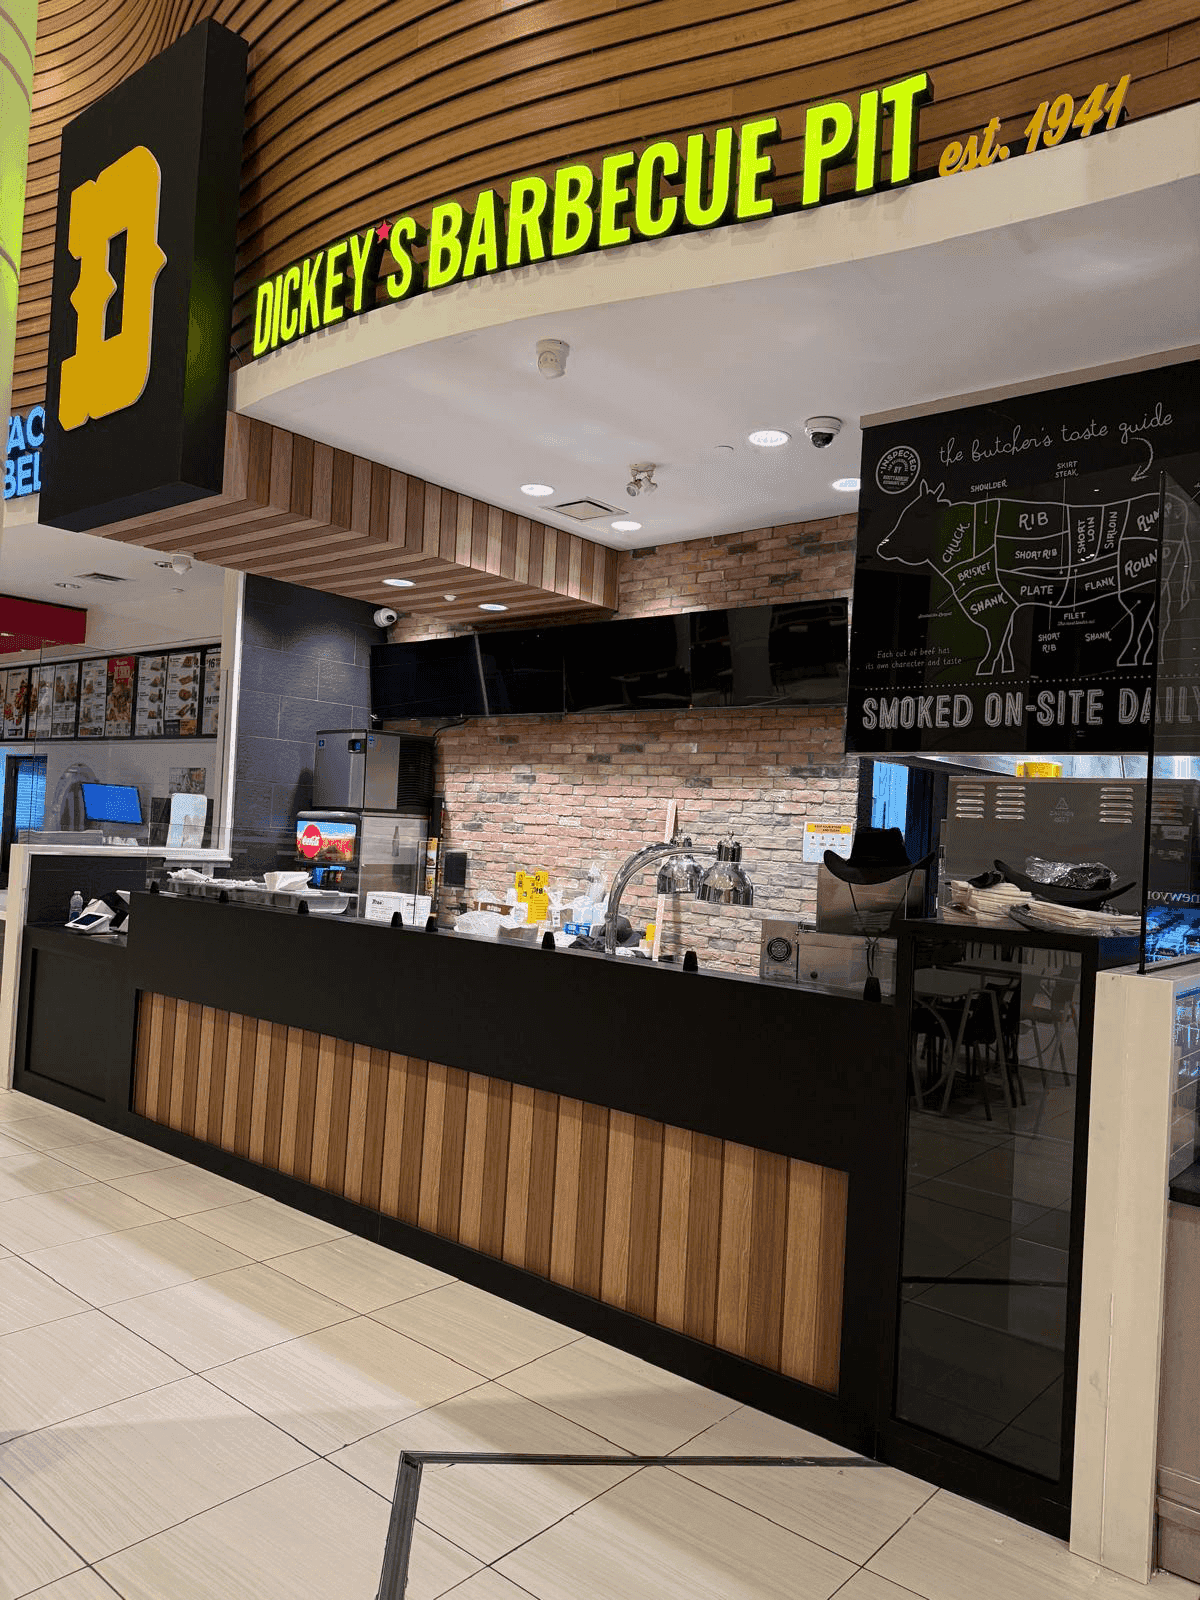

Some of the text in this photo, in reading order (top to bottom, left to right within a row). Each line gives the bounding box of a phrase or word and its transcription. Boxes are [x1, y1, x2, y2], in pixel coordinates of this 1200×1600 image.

[938, 74, 1132, 177] est. 1941
[427, 73, 928, 288] BARBECUE PIT
[58, 145, 168, 431] D
[7, 406, 46, 455] AC
[940, 402, 1173, 467] the butcher's taste guide
[880, 450, 917, 473] INSPECTED
[1057, 460, 1078, 470] SKIRT
[4, 452, 42, 499] BEL
[1055, 469, 1078, 478] STEAK
[970, 480, 1008, 493] SHOULDER
[1018, 511, 1049, 530] RIB
[1087, 516, 1096, 542] LOIN
[1104, 511, 1118, 549] SIRLOIN
[942, 521, 971, 564] CHUCK
[1077, 519, 1086, 554] SHORT
[1015, 549, 1058, 560] SHORT RIB
[957, 562, 992, 581] BRISKET
[1020, 584, 1054, 596] PLATE
[1084, 574, 1116, 591] FLANK
[970, 592, 1009, 615] SHANK
[1063, 611, 1087, 620] FILET
[1037, 631, 1061, 642] SHORT
[1085, 630, 1112, 642] SHANK
[877, 647, 950, 659] Each cut of beef has
[1042, 643, 1057, 653] RIB
[891, 661, 925, 669] character
[927, 657, 941, 666] and
[943, 657, 963, 665] taste
[862, 693, 973, 730] SMOKED
[984, 688, 1104, 727] ON-SITE
